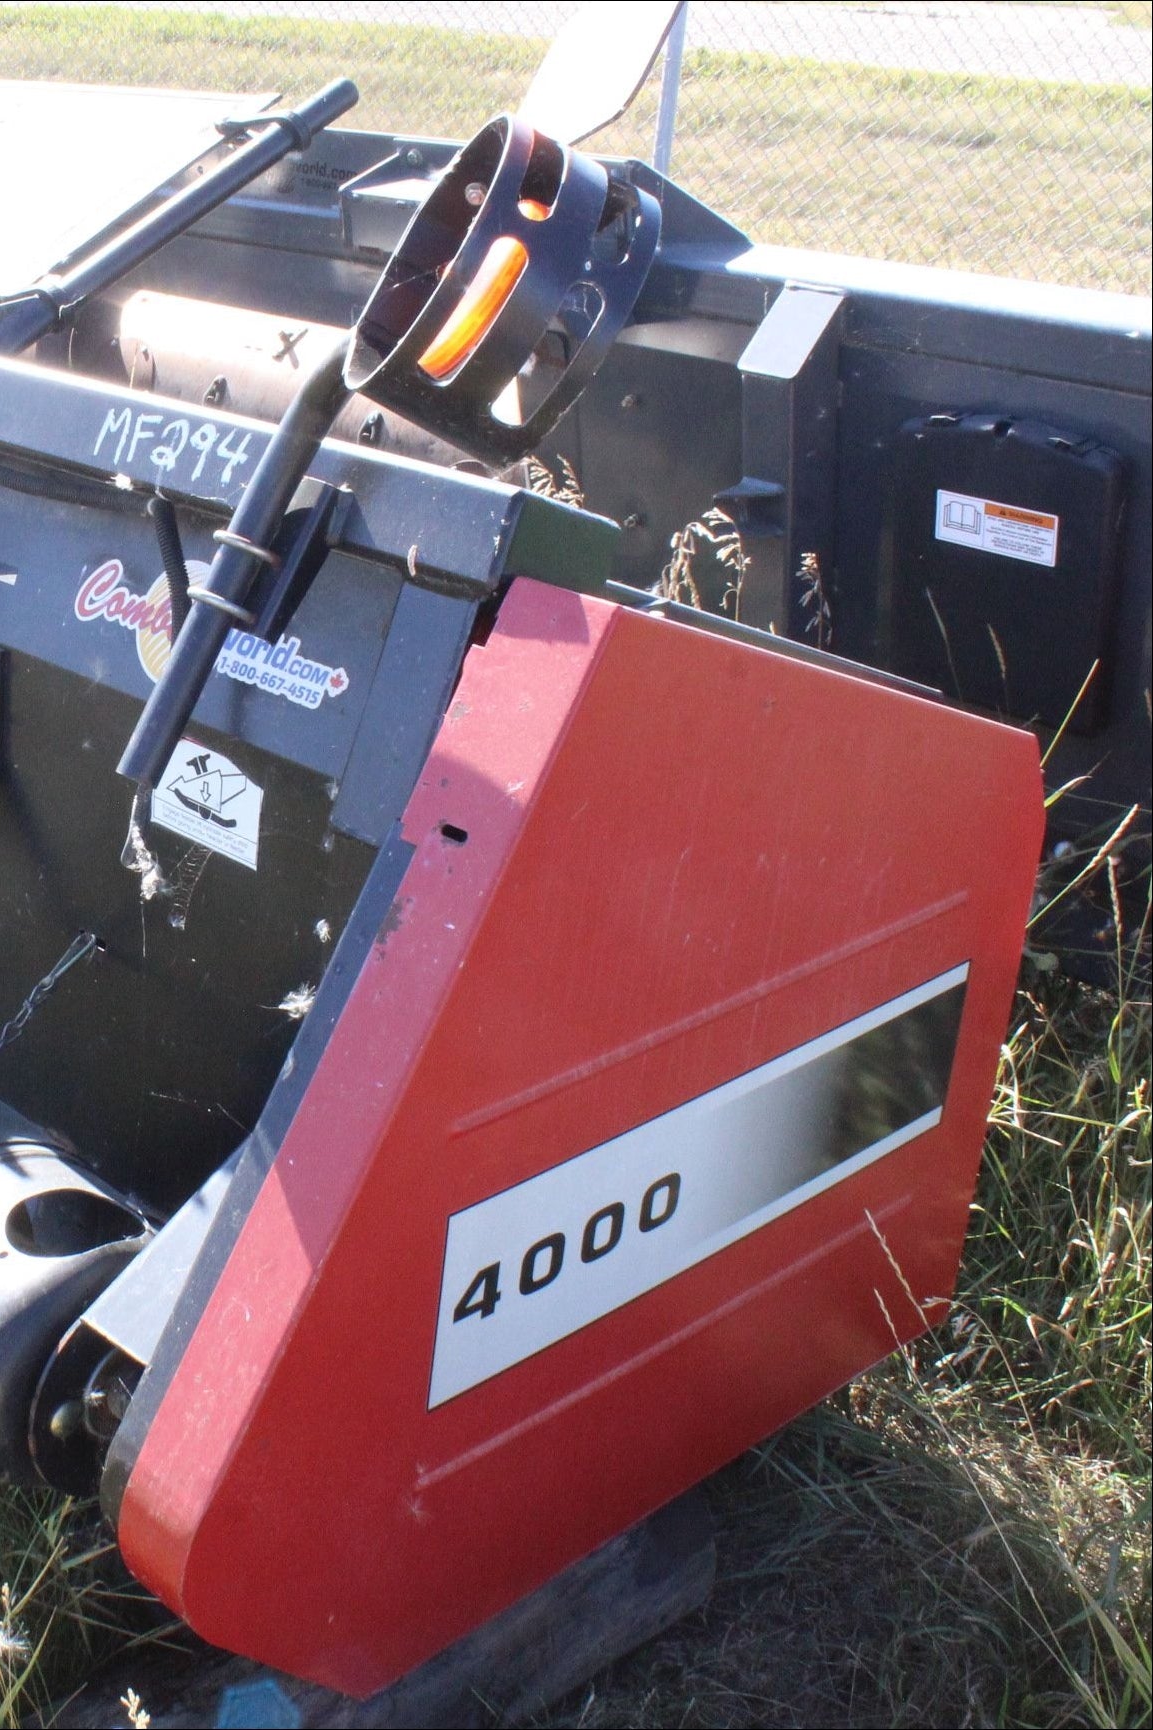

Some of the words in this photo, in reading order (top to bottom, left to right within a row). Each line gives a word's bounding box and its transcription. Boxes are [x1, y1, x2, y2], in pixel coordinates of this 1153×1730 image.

[94, 407, 253, 485] MF294
[77, 561, 173, 641] Comb
[220, 656, 321, 705] 1-800-667-4515
[453, 1172, 681, 1324] 4000
